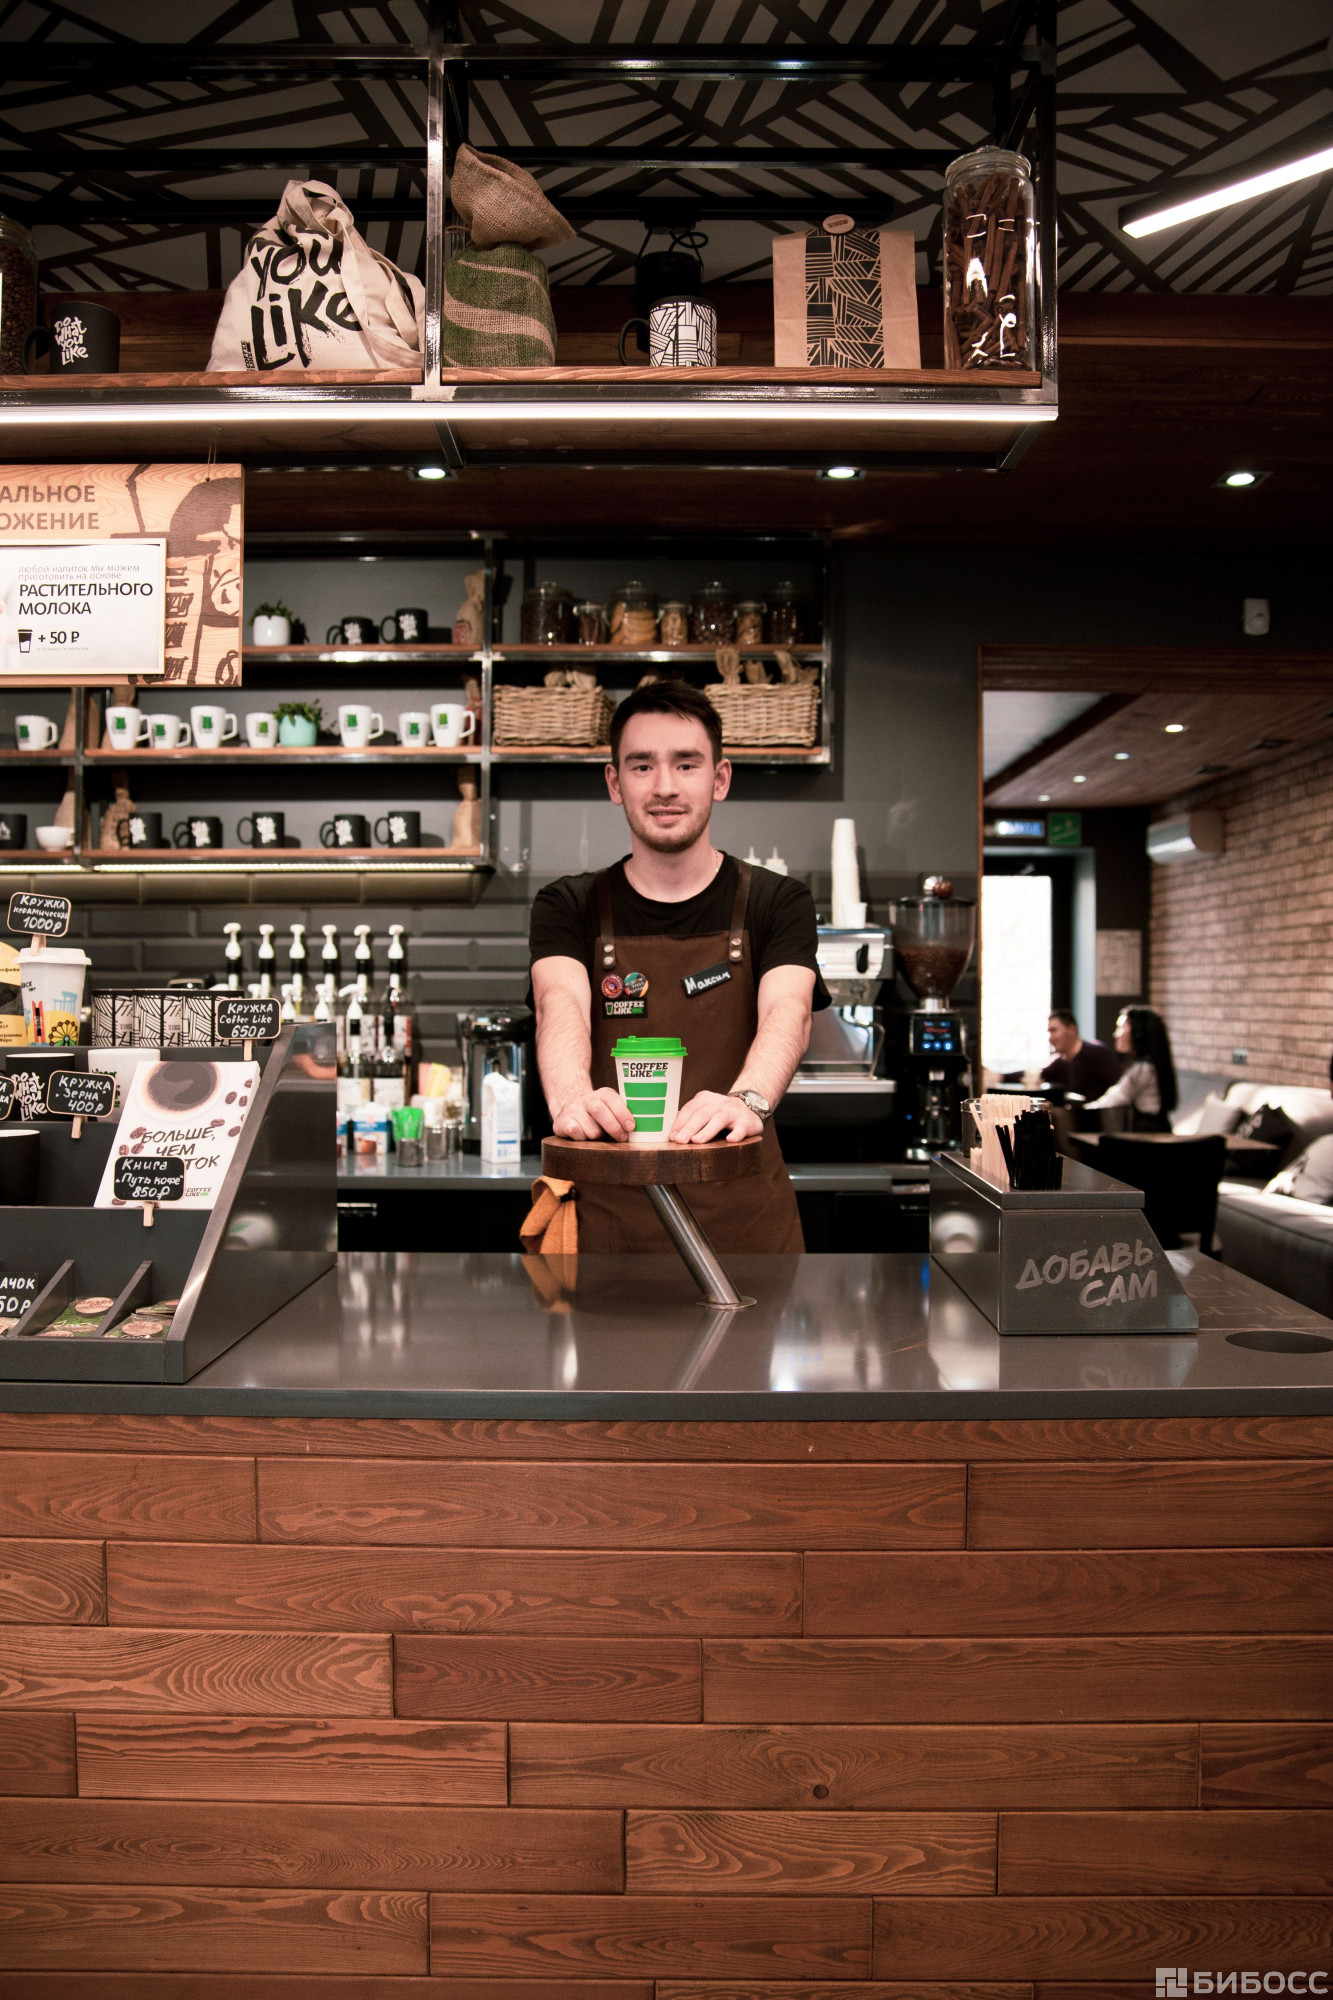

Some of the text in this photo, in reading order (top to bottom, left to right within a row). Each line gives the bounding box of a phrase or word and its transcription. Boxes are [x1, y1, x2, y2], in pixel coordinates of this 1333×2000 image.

[251, 239, 343, 301] YOU
[54, 317, 71, 333] DO
[61, 335, 83, 351] YOU
[0, 485, 95, 503] АЛЬНОЕ
[19, 565, 49, 573] любой
[52, 565, 88, 573] напиток
[19, 573, 74, 582] приготовить
[90, 572, 121, 580] основе
[19, 582, 153, 597] РАСТИТЕЛЬНОГО
[19, 602, 92, 615] МОЛОКА
[50, 631, 67, 644] 50
[684, 971, 731, 994] Максим
[613, 1007, 632, 1015] LIKE
[220, 1014, 272, 1024] Coffee Like
[630, 1062, 668, 1070] COFFEE
[11, 1072, 29, 1086] DO
[59, 1075, 111, 1091] КРУЖКА
[19, 1091, 41, 1107] YOU
[141, 1127, 215, 1144] БОЛЬШЕ,
[156, 1143, 195, 1156] ЧЕМ
[121, 1158, 167, 1171] Книга
[1015, 1239, 1154, 1290] ДОБАВЬ
[1079, 1269, 1157, 1309] САМ
